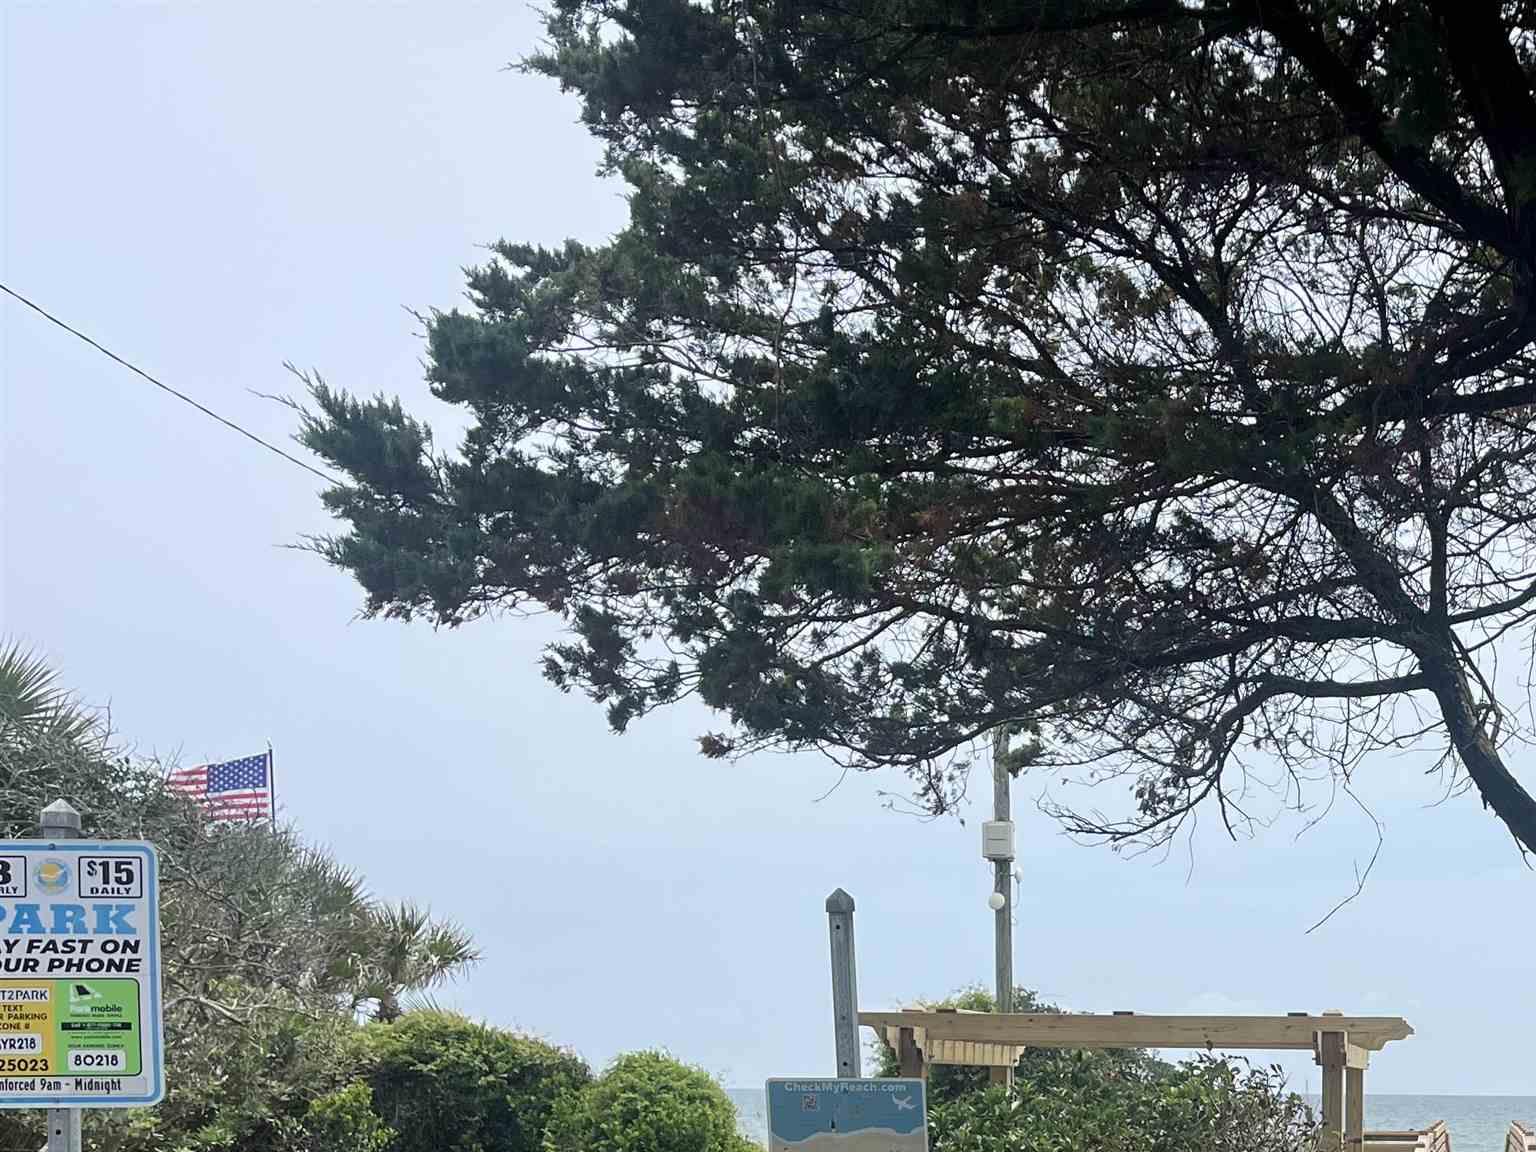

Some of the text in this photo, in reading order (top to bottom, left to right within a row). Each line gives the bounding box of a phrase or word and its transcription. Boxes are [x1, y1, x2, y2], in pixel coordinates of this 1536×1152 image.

[87, 860, 134, 885] $15
[26, 939, 94, 954] FAST
[100, 939, 141, 954] ON
[47, 958, 142, 973] PHONE
[3, 1004, 23, 1012] TEXT
[0, 1022, 20, 1030] ONE
[0, 1039, 36, 1050] YR218
[74, 1055, 119, 1066] 80218
[40, 1078, 61, 1091] 9am
[74, 1079, 121, 1094] Midnight
